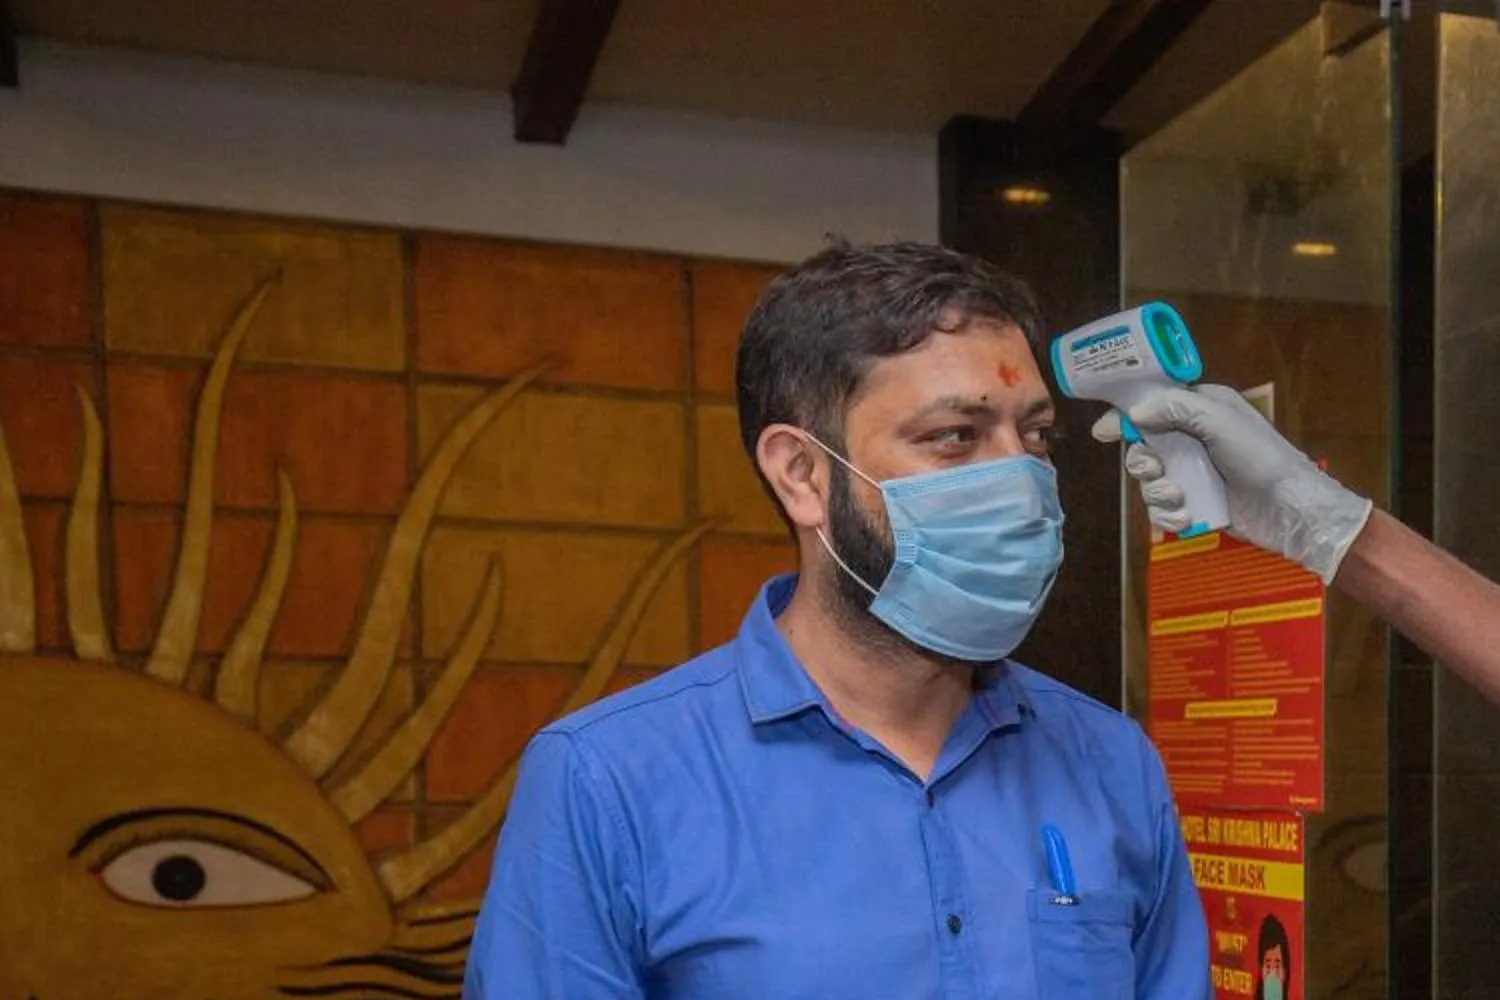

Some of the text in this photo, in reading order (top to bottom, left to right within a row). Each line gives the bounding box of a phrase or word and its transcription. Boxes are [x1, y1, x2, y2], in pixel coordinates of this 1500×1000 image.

[1264, 821, 1297, 852] PALACE
[1194, 857, 1265, 890] FACE MASK
[1223, 968, 1252, 996] ENTER
